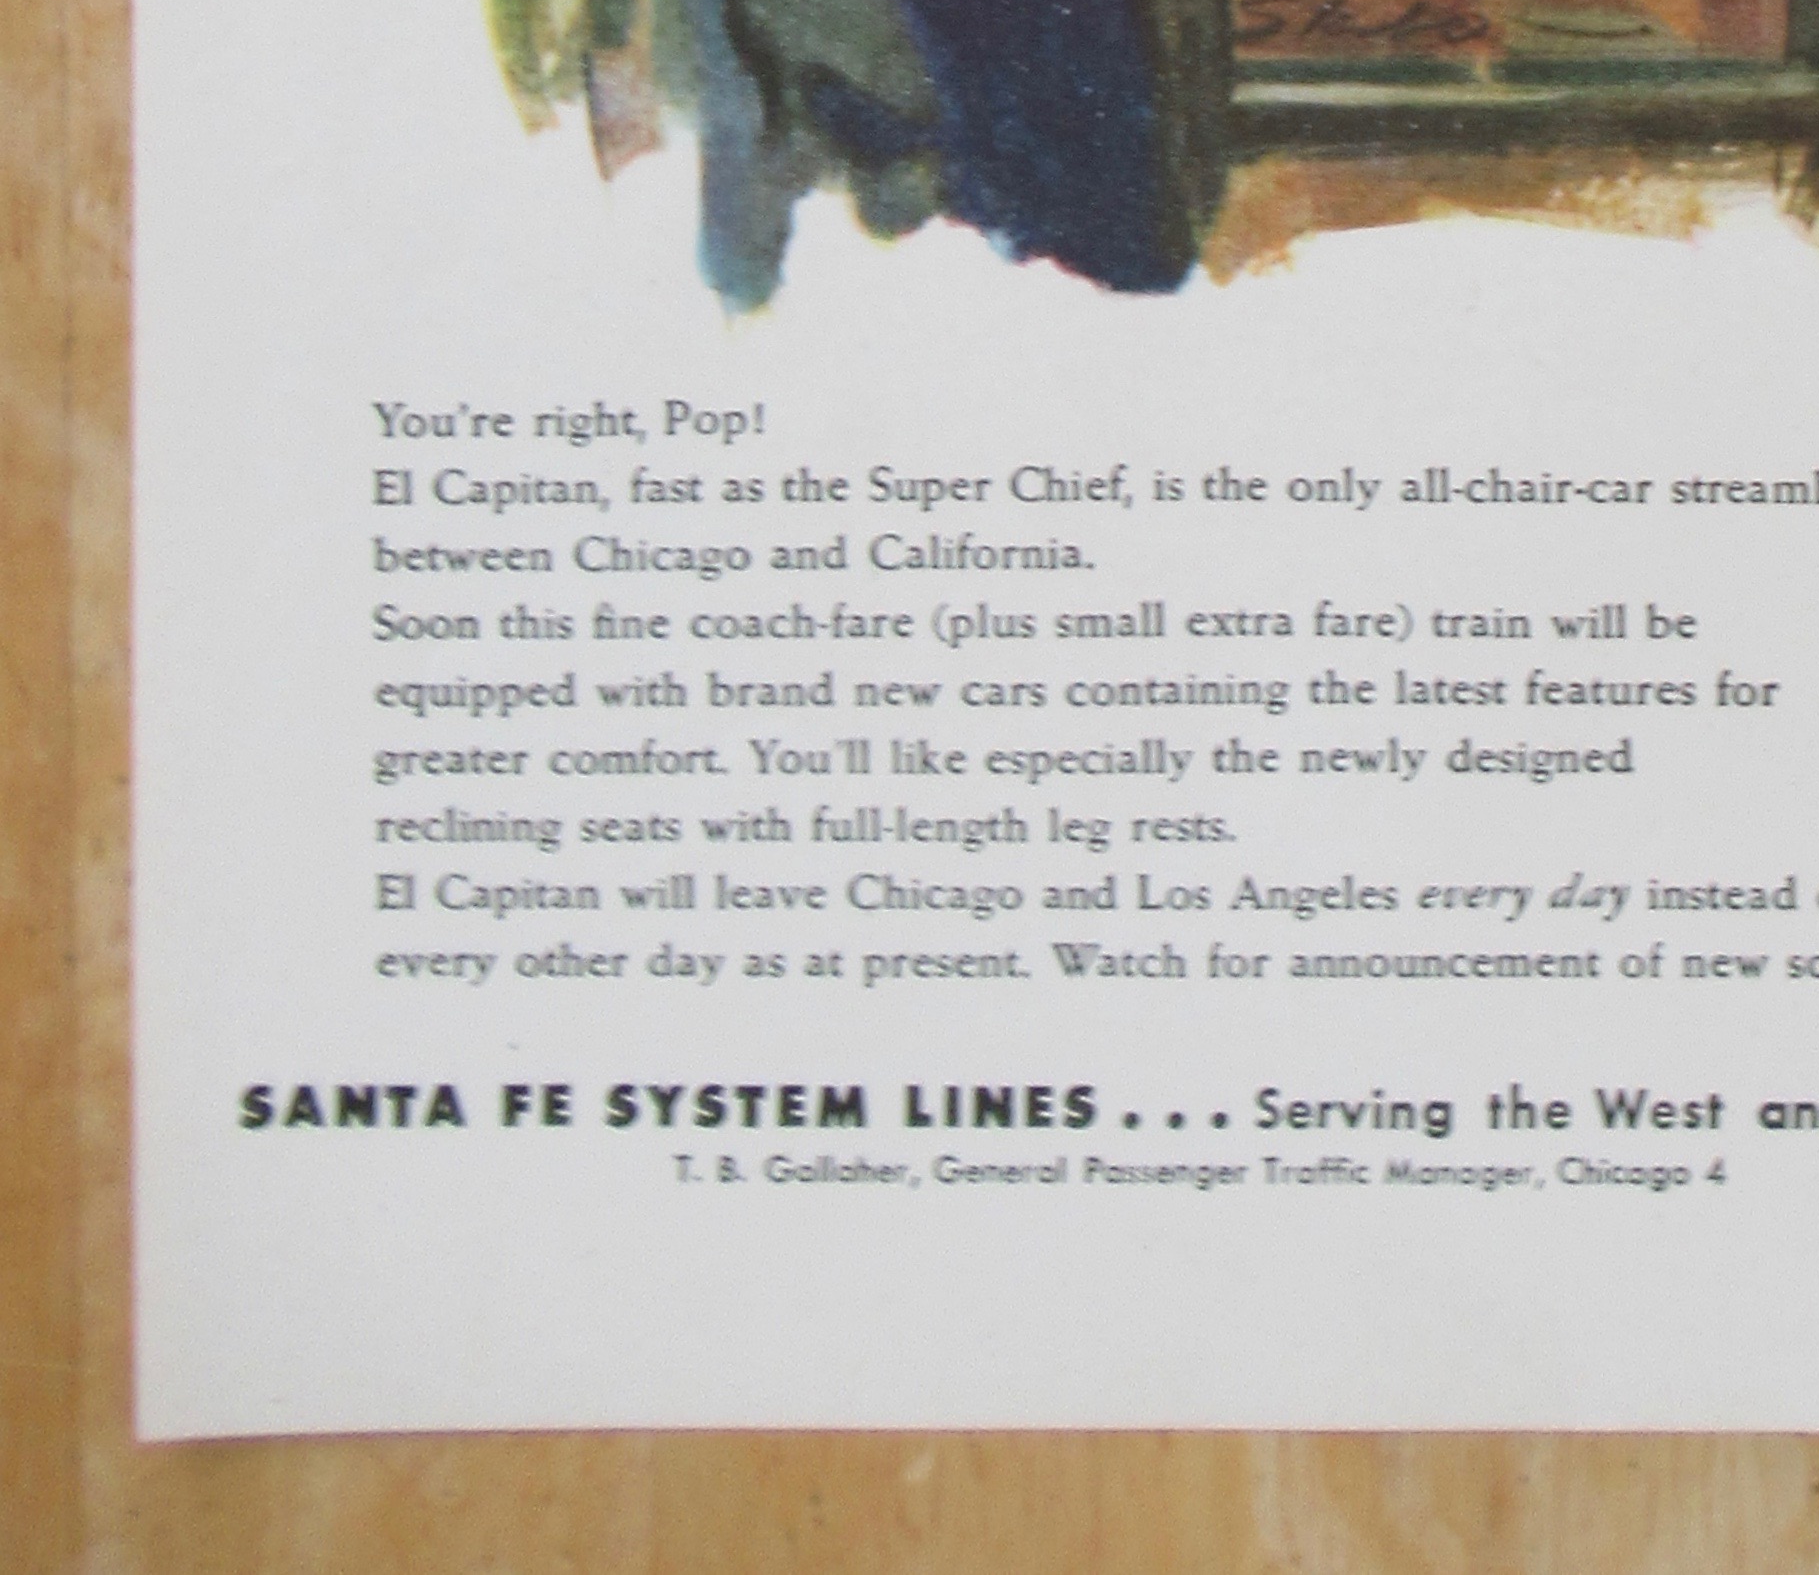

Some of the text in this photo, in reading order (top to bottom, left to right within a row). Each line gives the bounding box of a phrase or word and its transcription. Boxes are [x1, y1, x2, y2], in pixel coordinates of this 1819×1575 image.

[373, 400, 765, 448] You're right, Pop!
[374, 470, 414, 506] El
[433, 470, 611, 515] Capitan,
[631, 467, 705, 504] fast
[722, 480, 766, 504] as
[782, 468, 850, 503] the
[870, 466, 993, 513] Super
[1009, 465, 1133, 509] Chief,
[1154, 472, 1185, 502] is
[1203, 467, 1269, 502] the
[1287, 468, 1383, 512] only
[1401, 468, 1654, 505] all-chair-car
[374, 533, 1095, 582] between Chicago and California.
[374, 601, 1698, 650] Soon this fine coach-fare (plus small extra fare) train will be
[375, 670, 1781, 719] equipped with brand new cars containing the latest features for
[374, 738, 1636, 787] greater comfort. You'll like especially the newly designed
[376, 806, 1237, 854] reclining seats with full-length leg rests.
[376, 875, 417, 911] El
[435, 874, 601, 921] Capitan
[620, 875, 697, 910] will
[717, 876, 828, 911] leave
[847, 874, 1025, 922] Chicago
[1043, 876, 1119, 911] and
[1138, 875, 1212, 912] Los
[1230, 876, 1400, 922] Angeles
[1418, 887, 1534, 924] every
[1549, 873, 1631, 923] day
[1648, 877, 1800, 912] instead
[376, 954, 498, 986] every
[516, 944, 629, 979] other
[648, 944, 726, 987] day
[744, 955, 787, 979] as
[805, 954, 844, 979] at
[863, 953, 1031, 989] present.
[1053, 944, 1187, 979] Watch
[1209, 943, 1272, 979] for
[1289, 954, 1602, 979] announcement
[1620, 943, 1665, 979] of
[1683, 956, 1770, 979] new
[238, 1084, 469, 1132] SANTA
[499, 1084, 575, 1129] FE
[604, 1084, 870, 1131] SYSTEM
[904, 1085, 1100, 1131] LINES
[1254, 1088, 1456, 1140] Serving
[1486, 1084, 1574, 1132] the
[1594, 1089, 1728, 1131] West
[674, 1155, 1728, 1193] T. B. Gallaher, General Passenger Traffic Manager, Chicago 4
